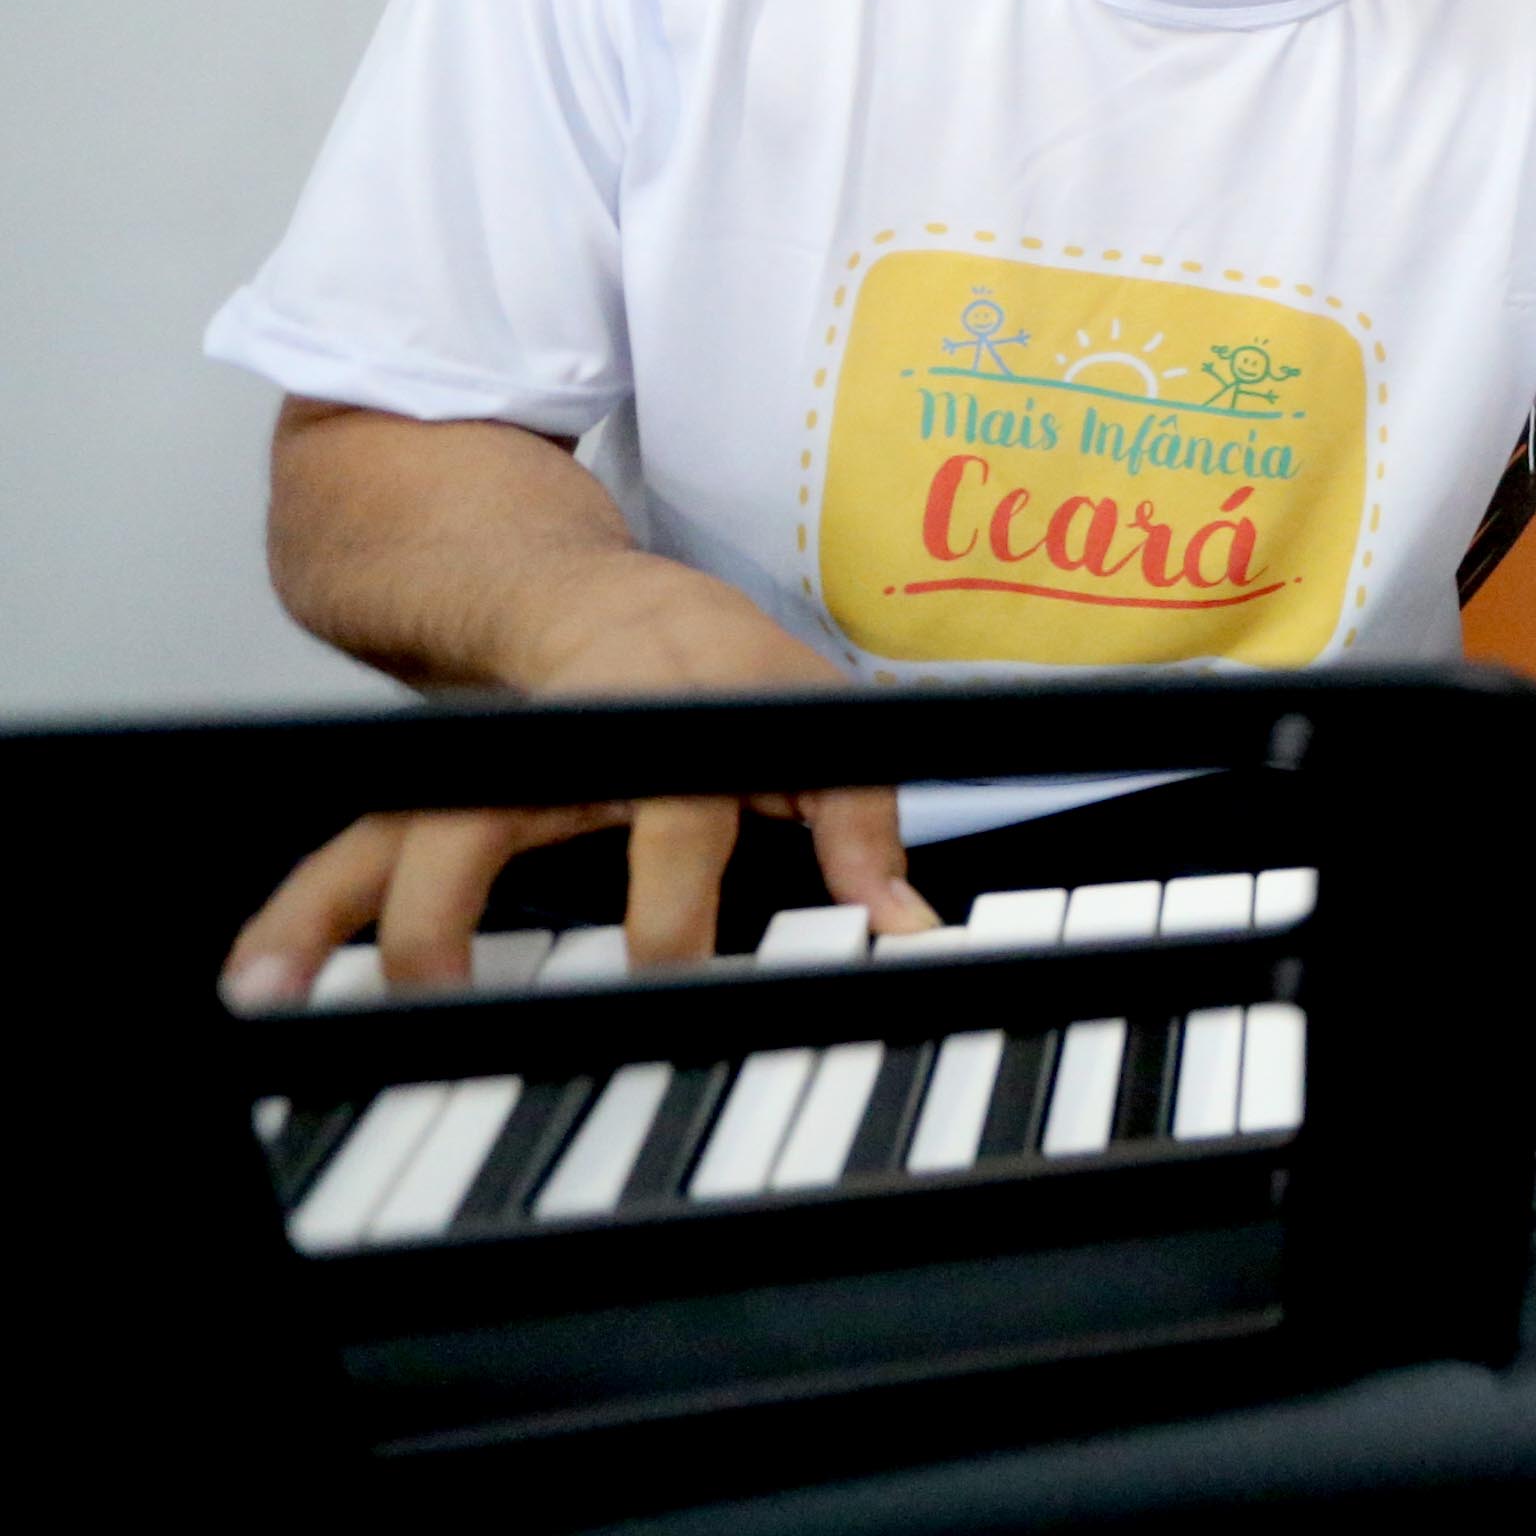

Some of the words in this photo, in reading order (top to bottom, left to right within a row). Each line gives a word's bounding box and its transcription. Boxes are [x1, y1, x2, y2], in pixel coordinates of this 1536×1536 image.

[917, 386, 1060, 451] Mais
[1080, 406, 1303, 480] Infância
[921, 454, 1270, 589] Ceará
